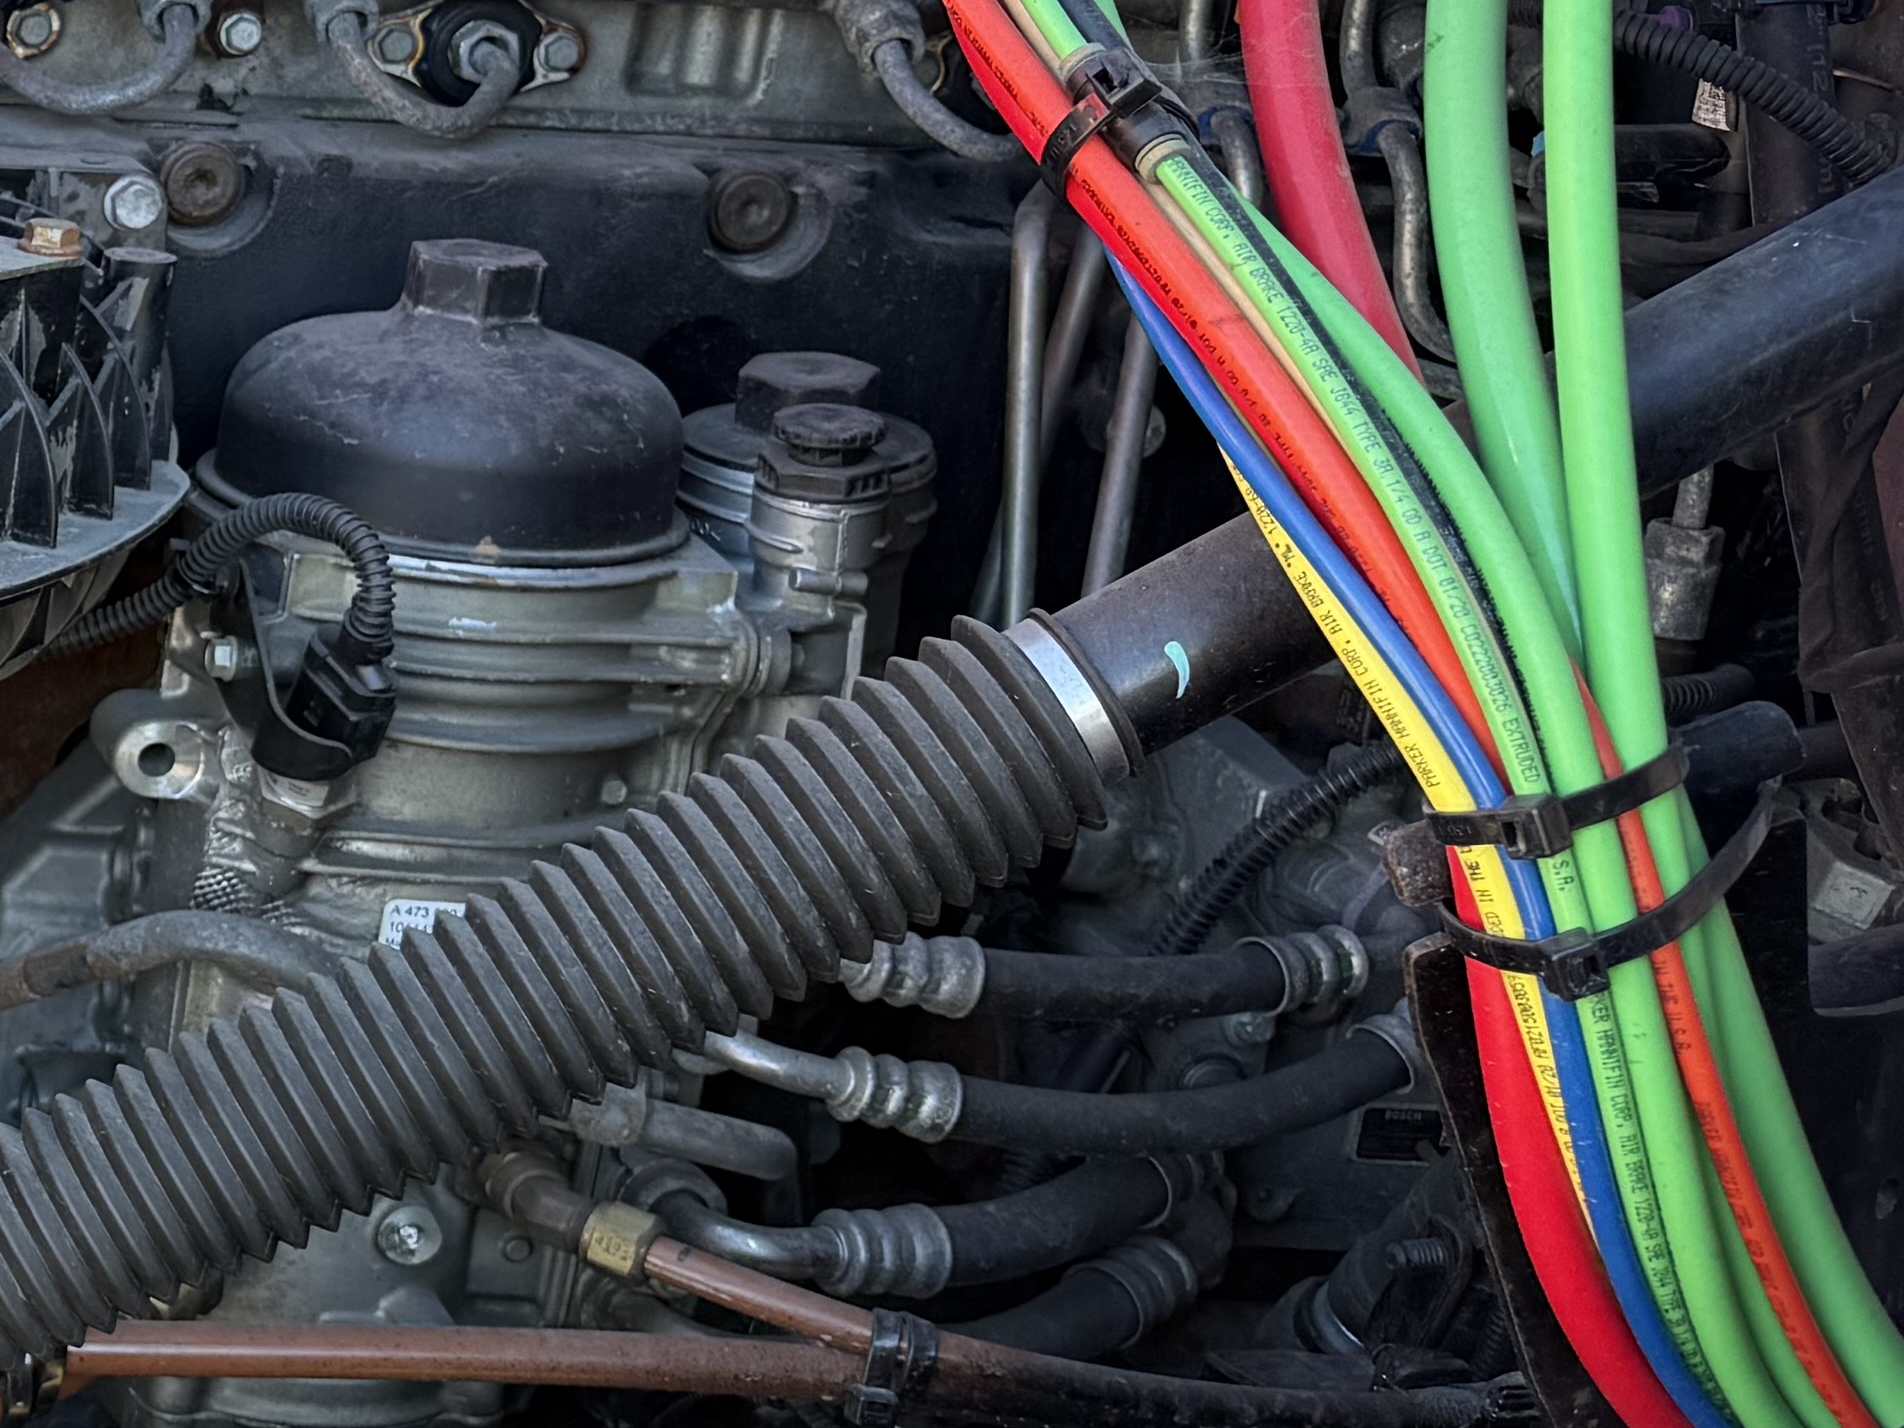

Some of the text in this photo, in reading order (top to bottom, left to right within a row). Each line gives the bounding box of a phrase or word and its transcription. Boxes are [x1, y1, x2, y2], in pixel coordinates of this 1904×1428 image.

[1233, 241, 1257, 268] AIR
[1249, 262, 1286, 304] BRAKE
[1353, 421, 1382, 454] TYPE
[1501, 714, 1543, 785] EXTRUDED
[1318, 609, 1343, 636] AIR
[1363, 679, 1411, 740] HANNIFIN
[1402, 743, 1441, 789] PARKER
[390, 904, 430, 918] A 473
